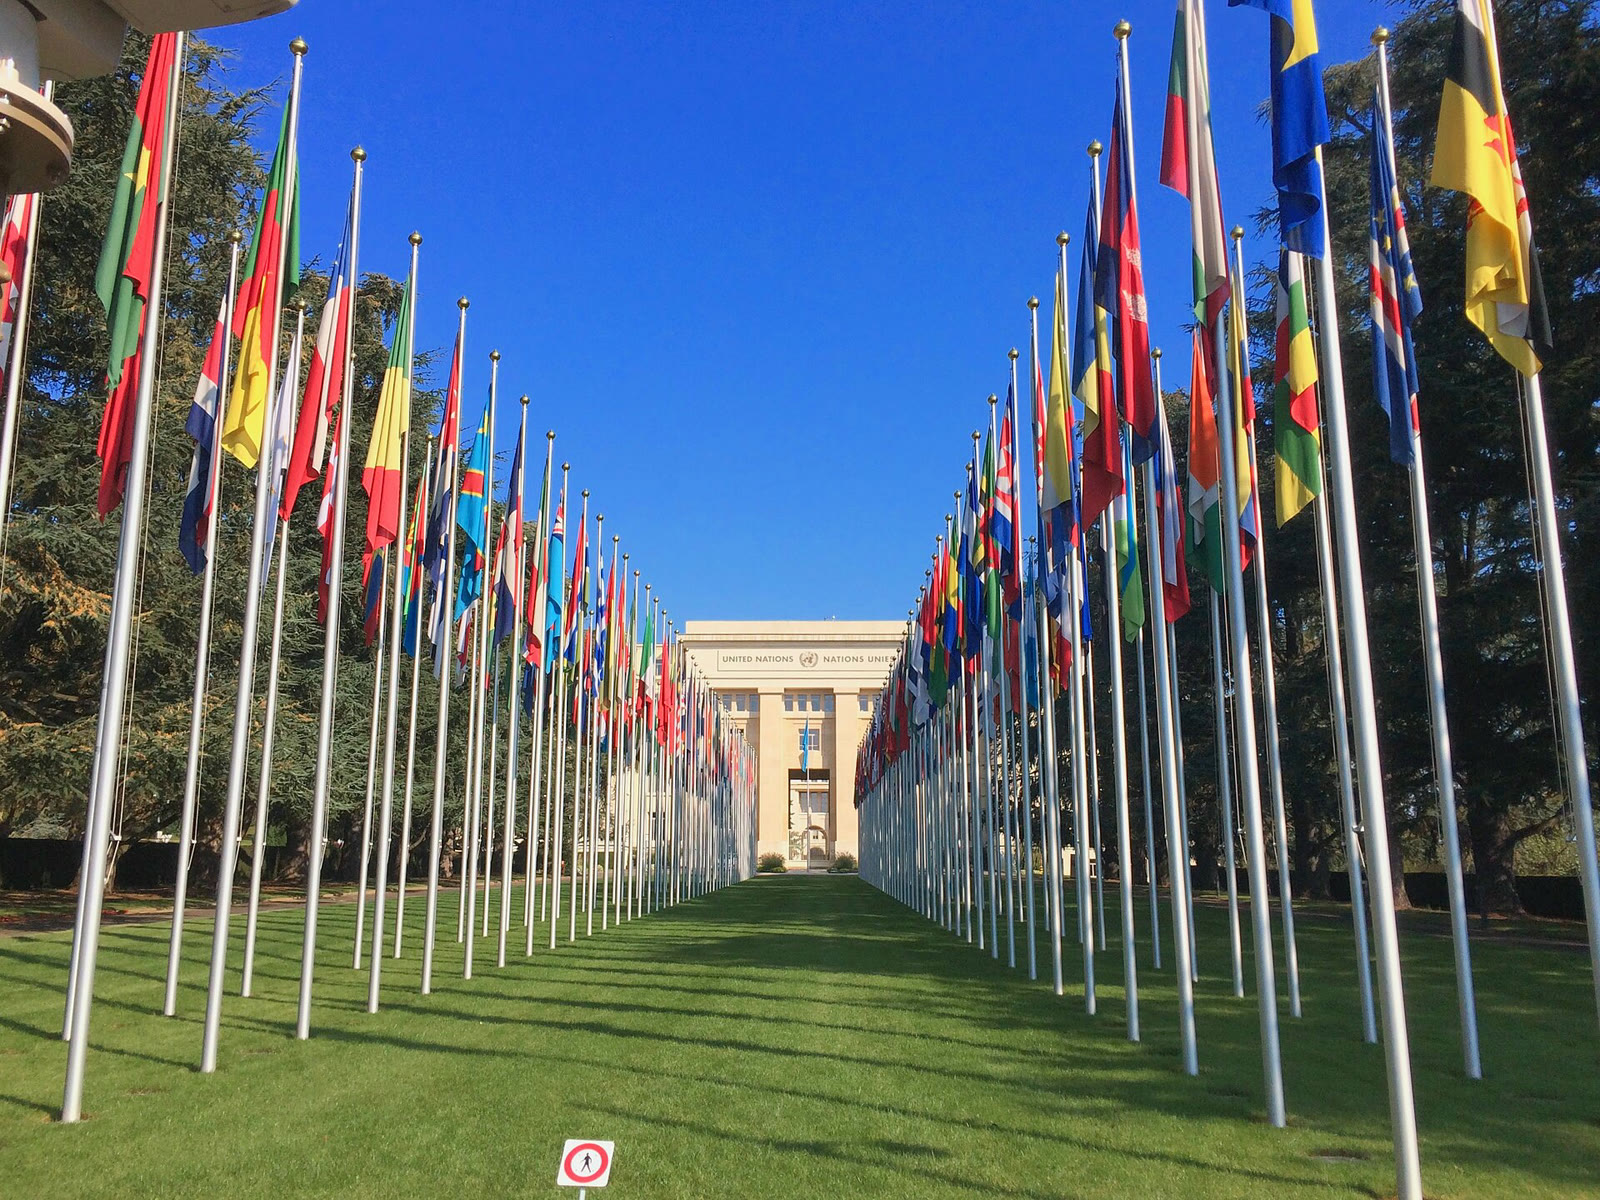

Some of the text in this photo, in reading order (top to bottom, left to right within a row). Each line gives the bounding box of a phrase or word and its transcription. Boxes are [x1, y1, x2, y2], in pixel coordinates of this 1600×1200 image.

[722, 655, 794, 663] UNITED NATIONS
[823, 655, 864, 663] NATIONS
